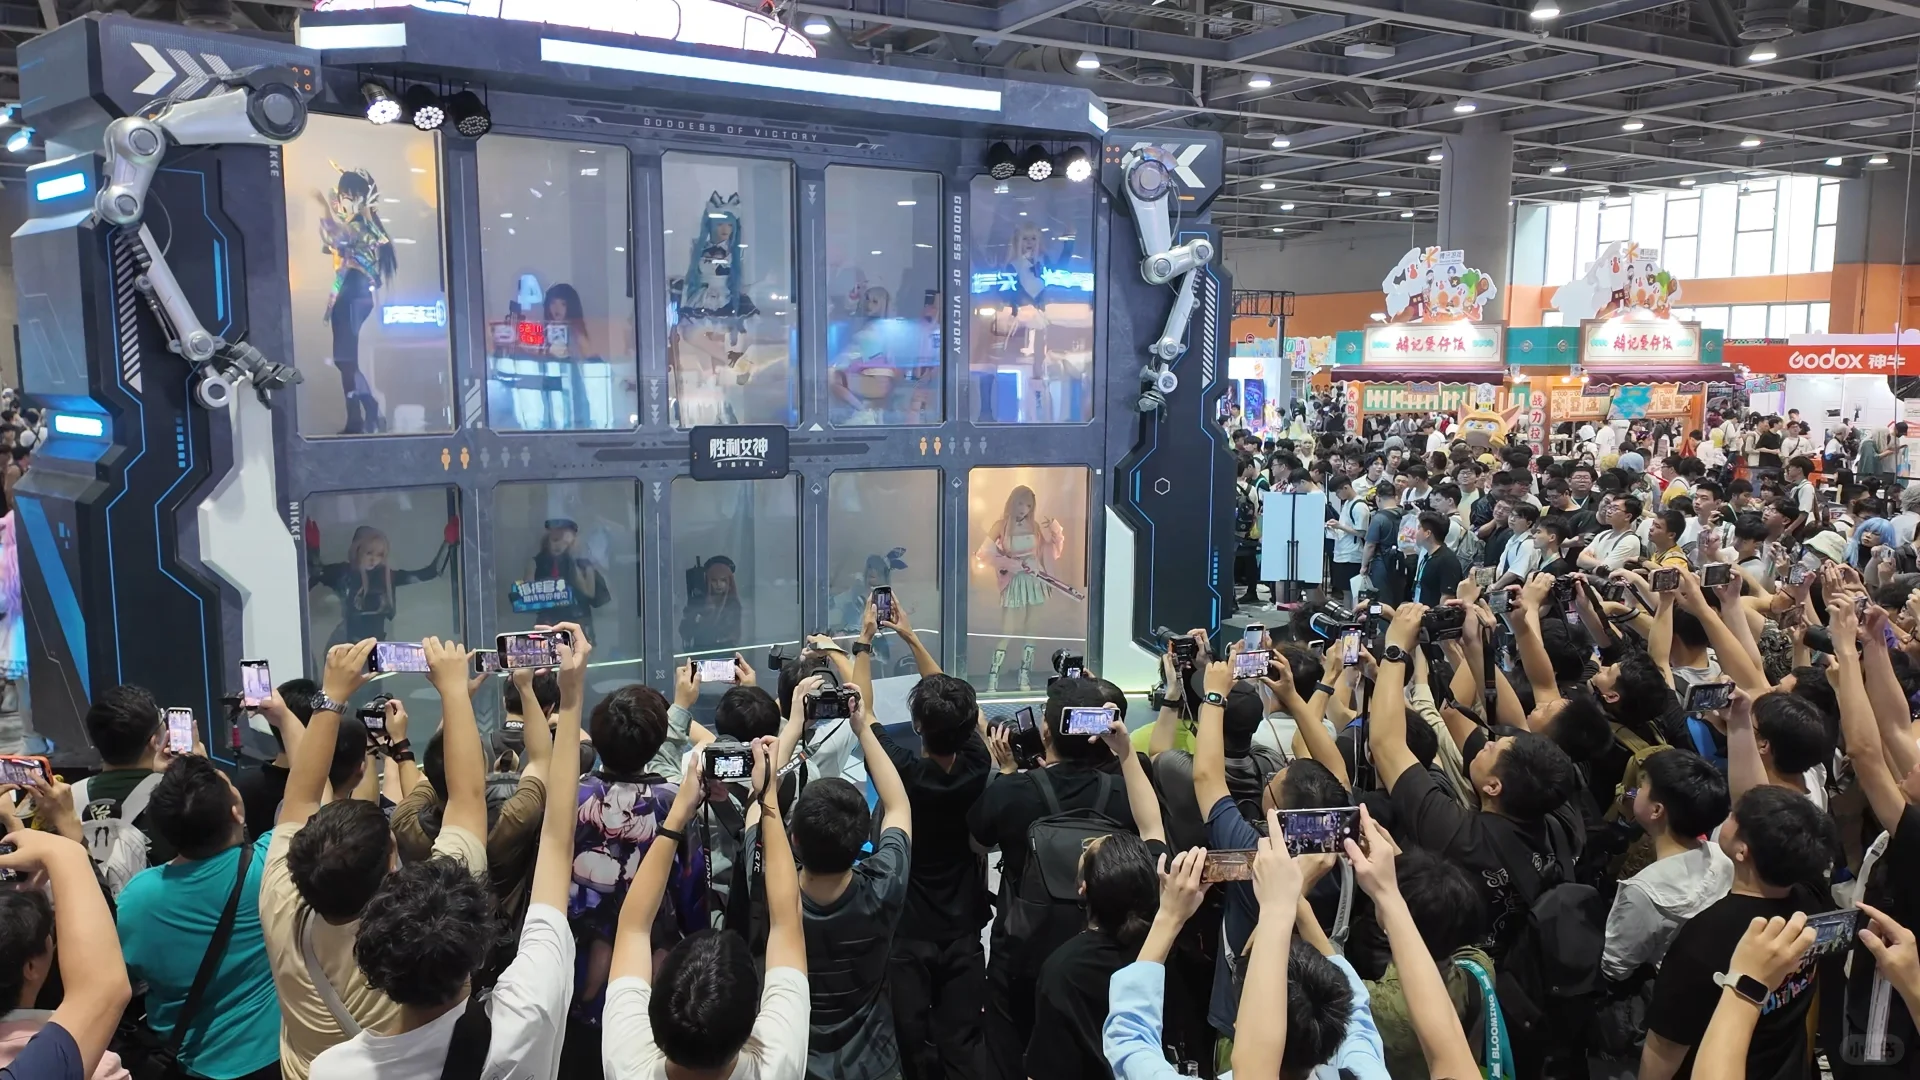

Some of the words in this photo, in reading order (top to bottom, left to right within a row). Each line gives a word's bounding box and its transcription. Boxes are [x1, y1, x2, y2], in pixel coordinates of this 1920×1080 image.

[643, 117, 716, 132] GODDESS
[727, 126, 744, 135] OF
[754, 128, 817, 142] VICTORY
[269, 145, 280, 177] IKKE
[953, 195, 962, 261] GODDESS
[953, 269, 961, 287] OF
[953, 295, 961, 354] VICTORY
[1788, 347, 1864, 370] Godox
[1868, 353, 1906, 370] 神牛
[709, 437, 769, 459] 胜利女神
[289, 501, 301, 541] NIKKE
[505, 721, 524, 729] SON
[1488, 994, 1501, 1060] BLOOMING
